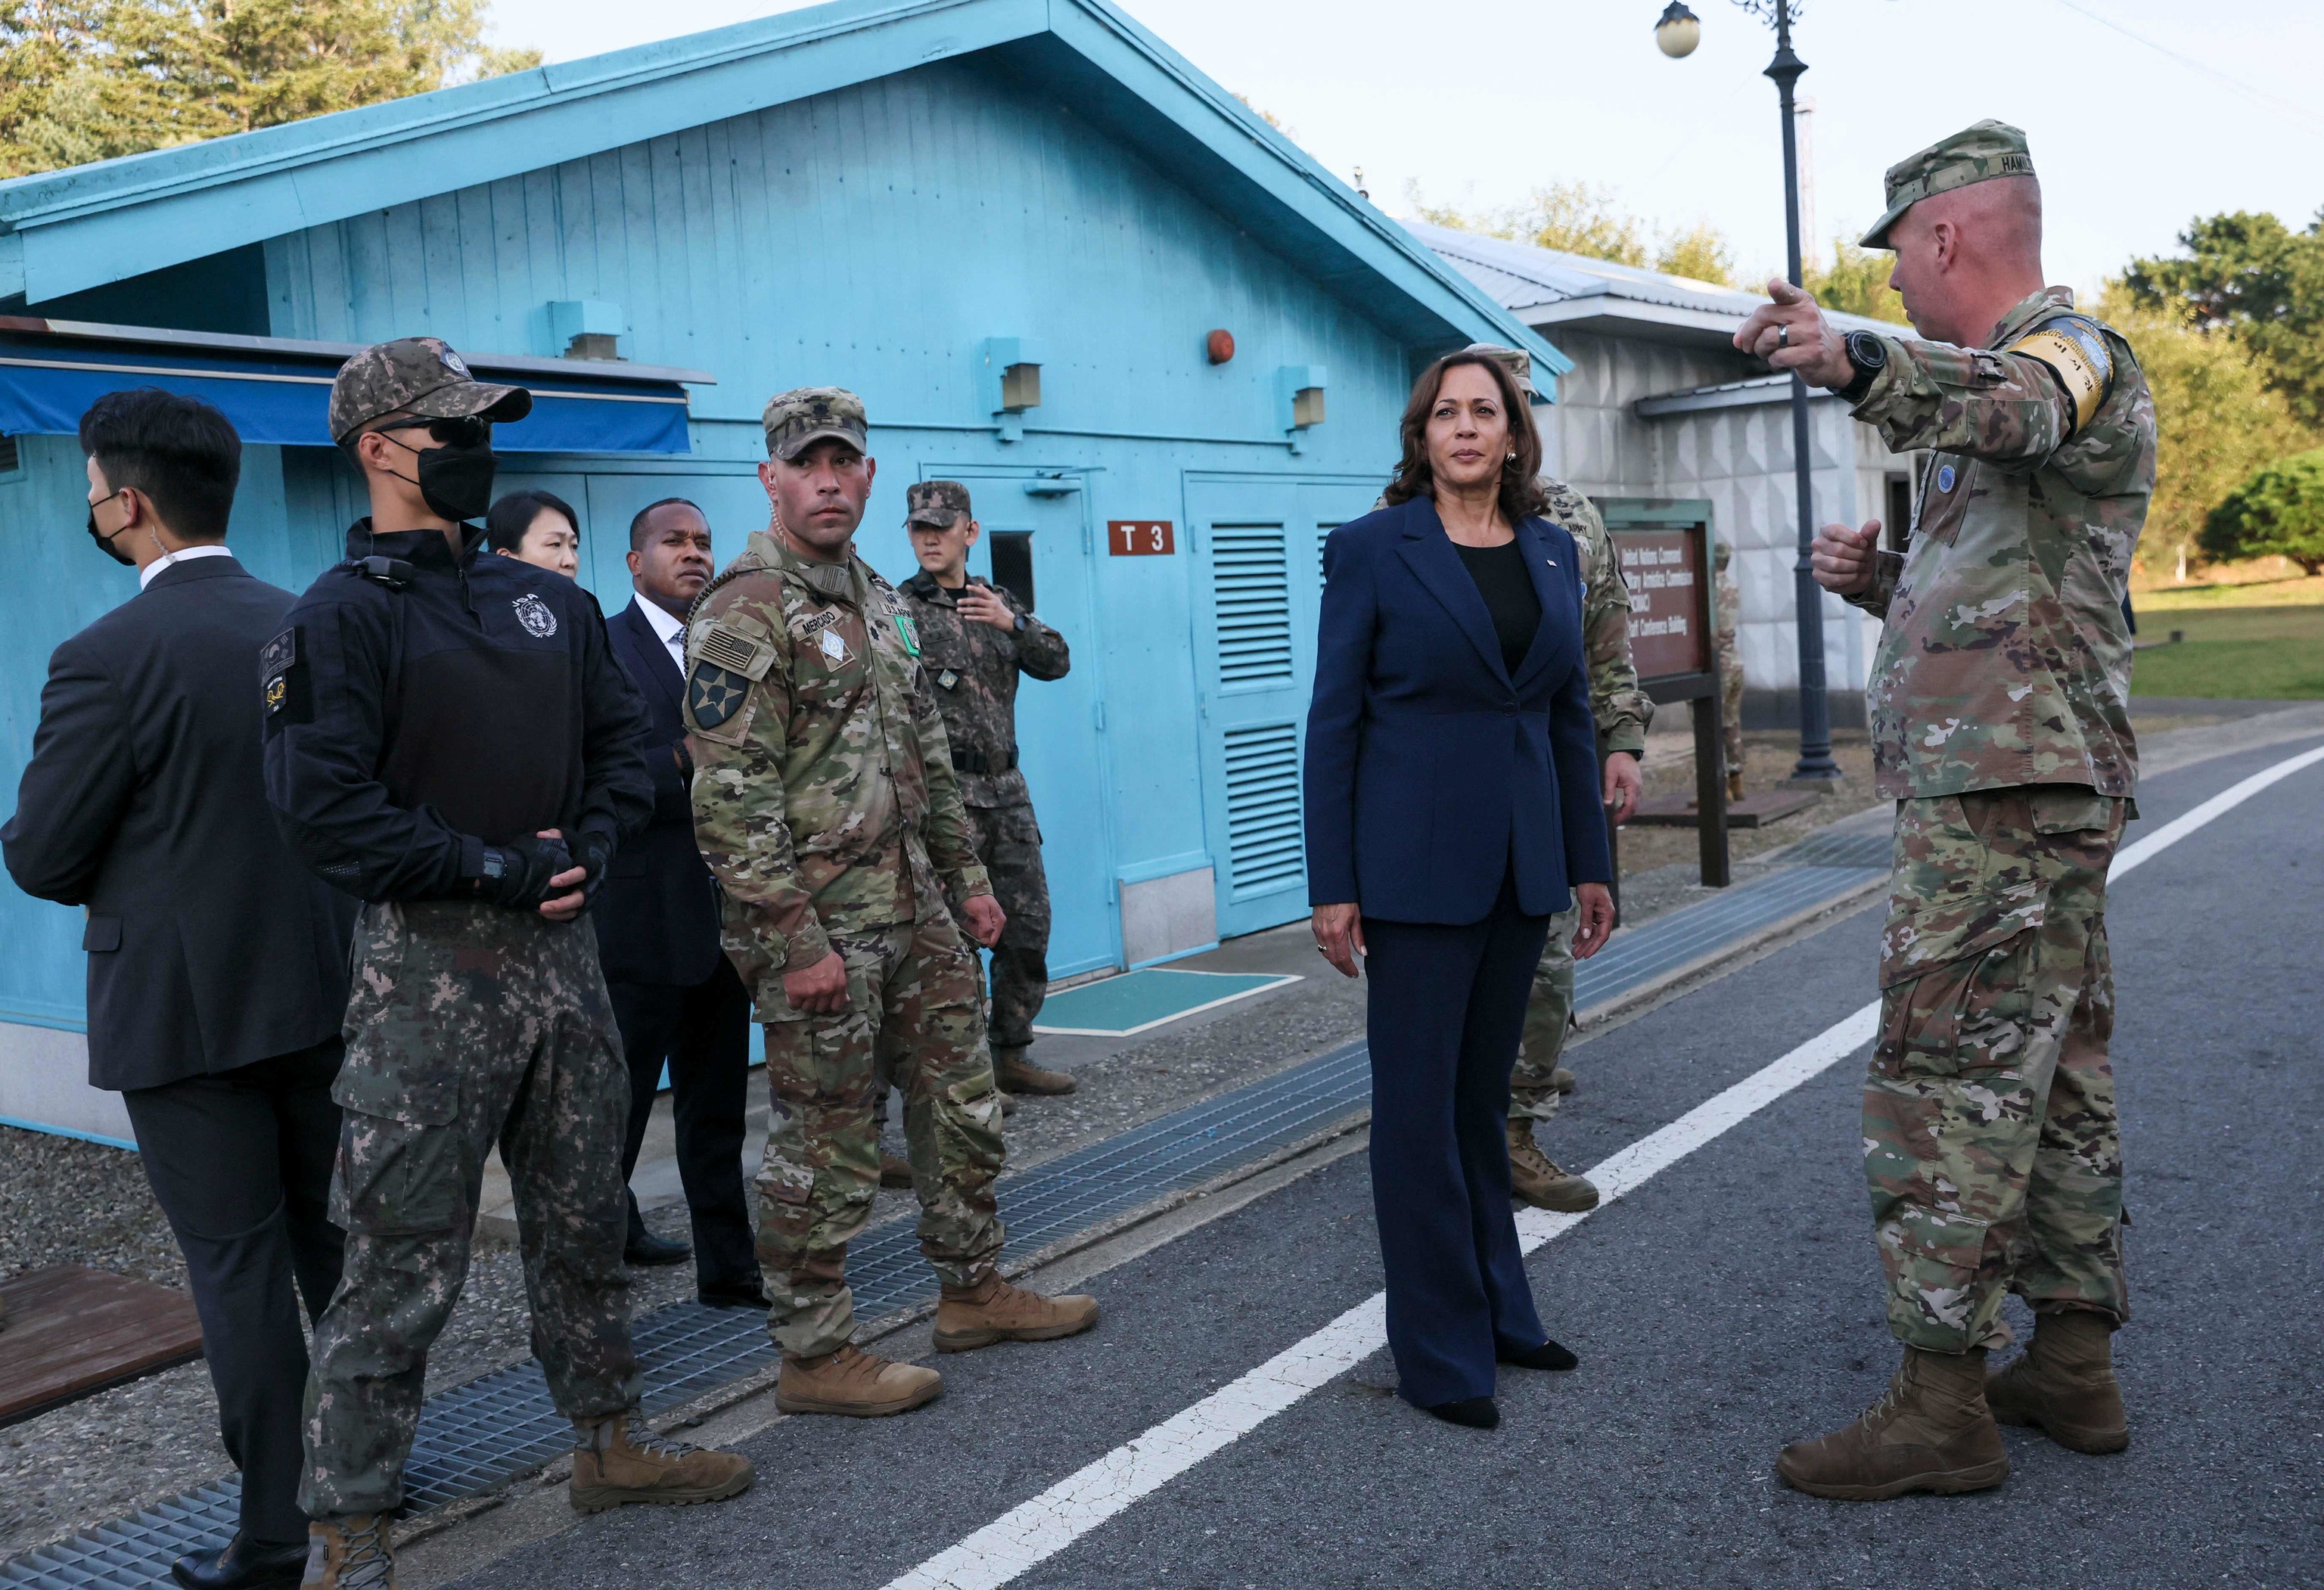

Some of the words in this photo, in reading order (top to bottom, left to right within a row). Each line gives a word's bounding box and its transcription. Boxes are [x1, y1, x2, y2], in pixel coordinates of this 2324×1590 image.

[1120, 525, 1136, 551] T
[1151, 525, 1164, 551] 3
[1568, 523, 1587, 535] ARMY
[1622, 548, 1639, 567] United
[1639, 546, 1658, 566] Nations
[511, 593, 539, 607] JSA
[802, 611, 836, 635] MERCADO
